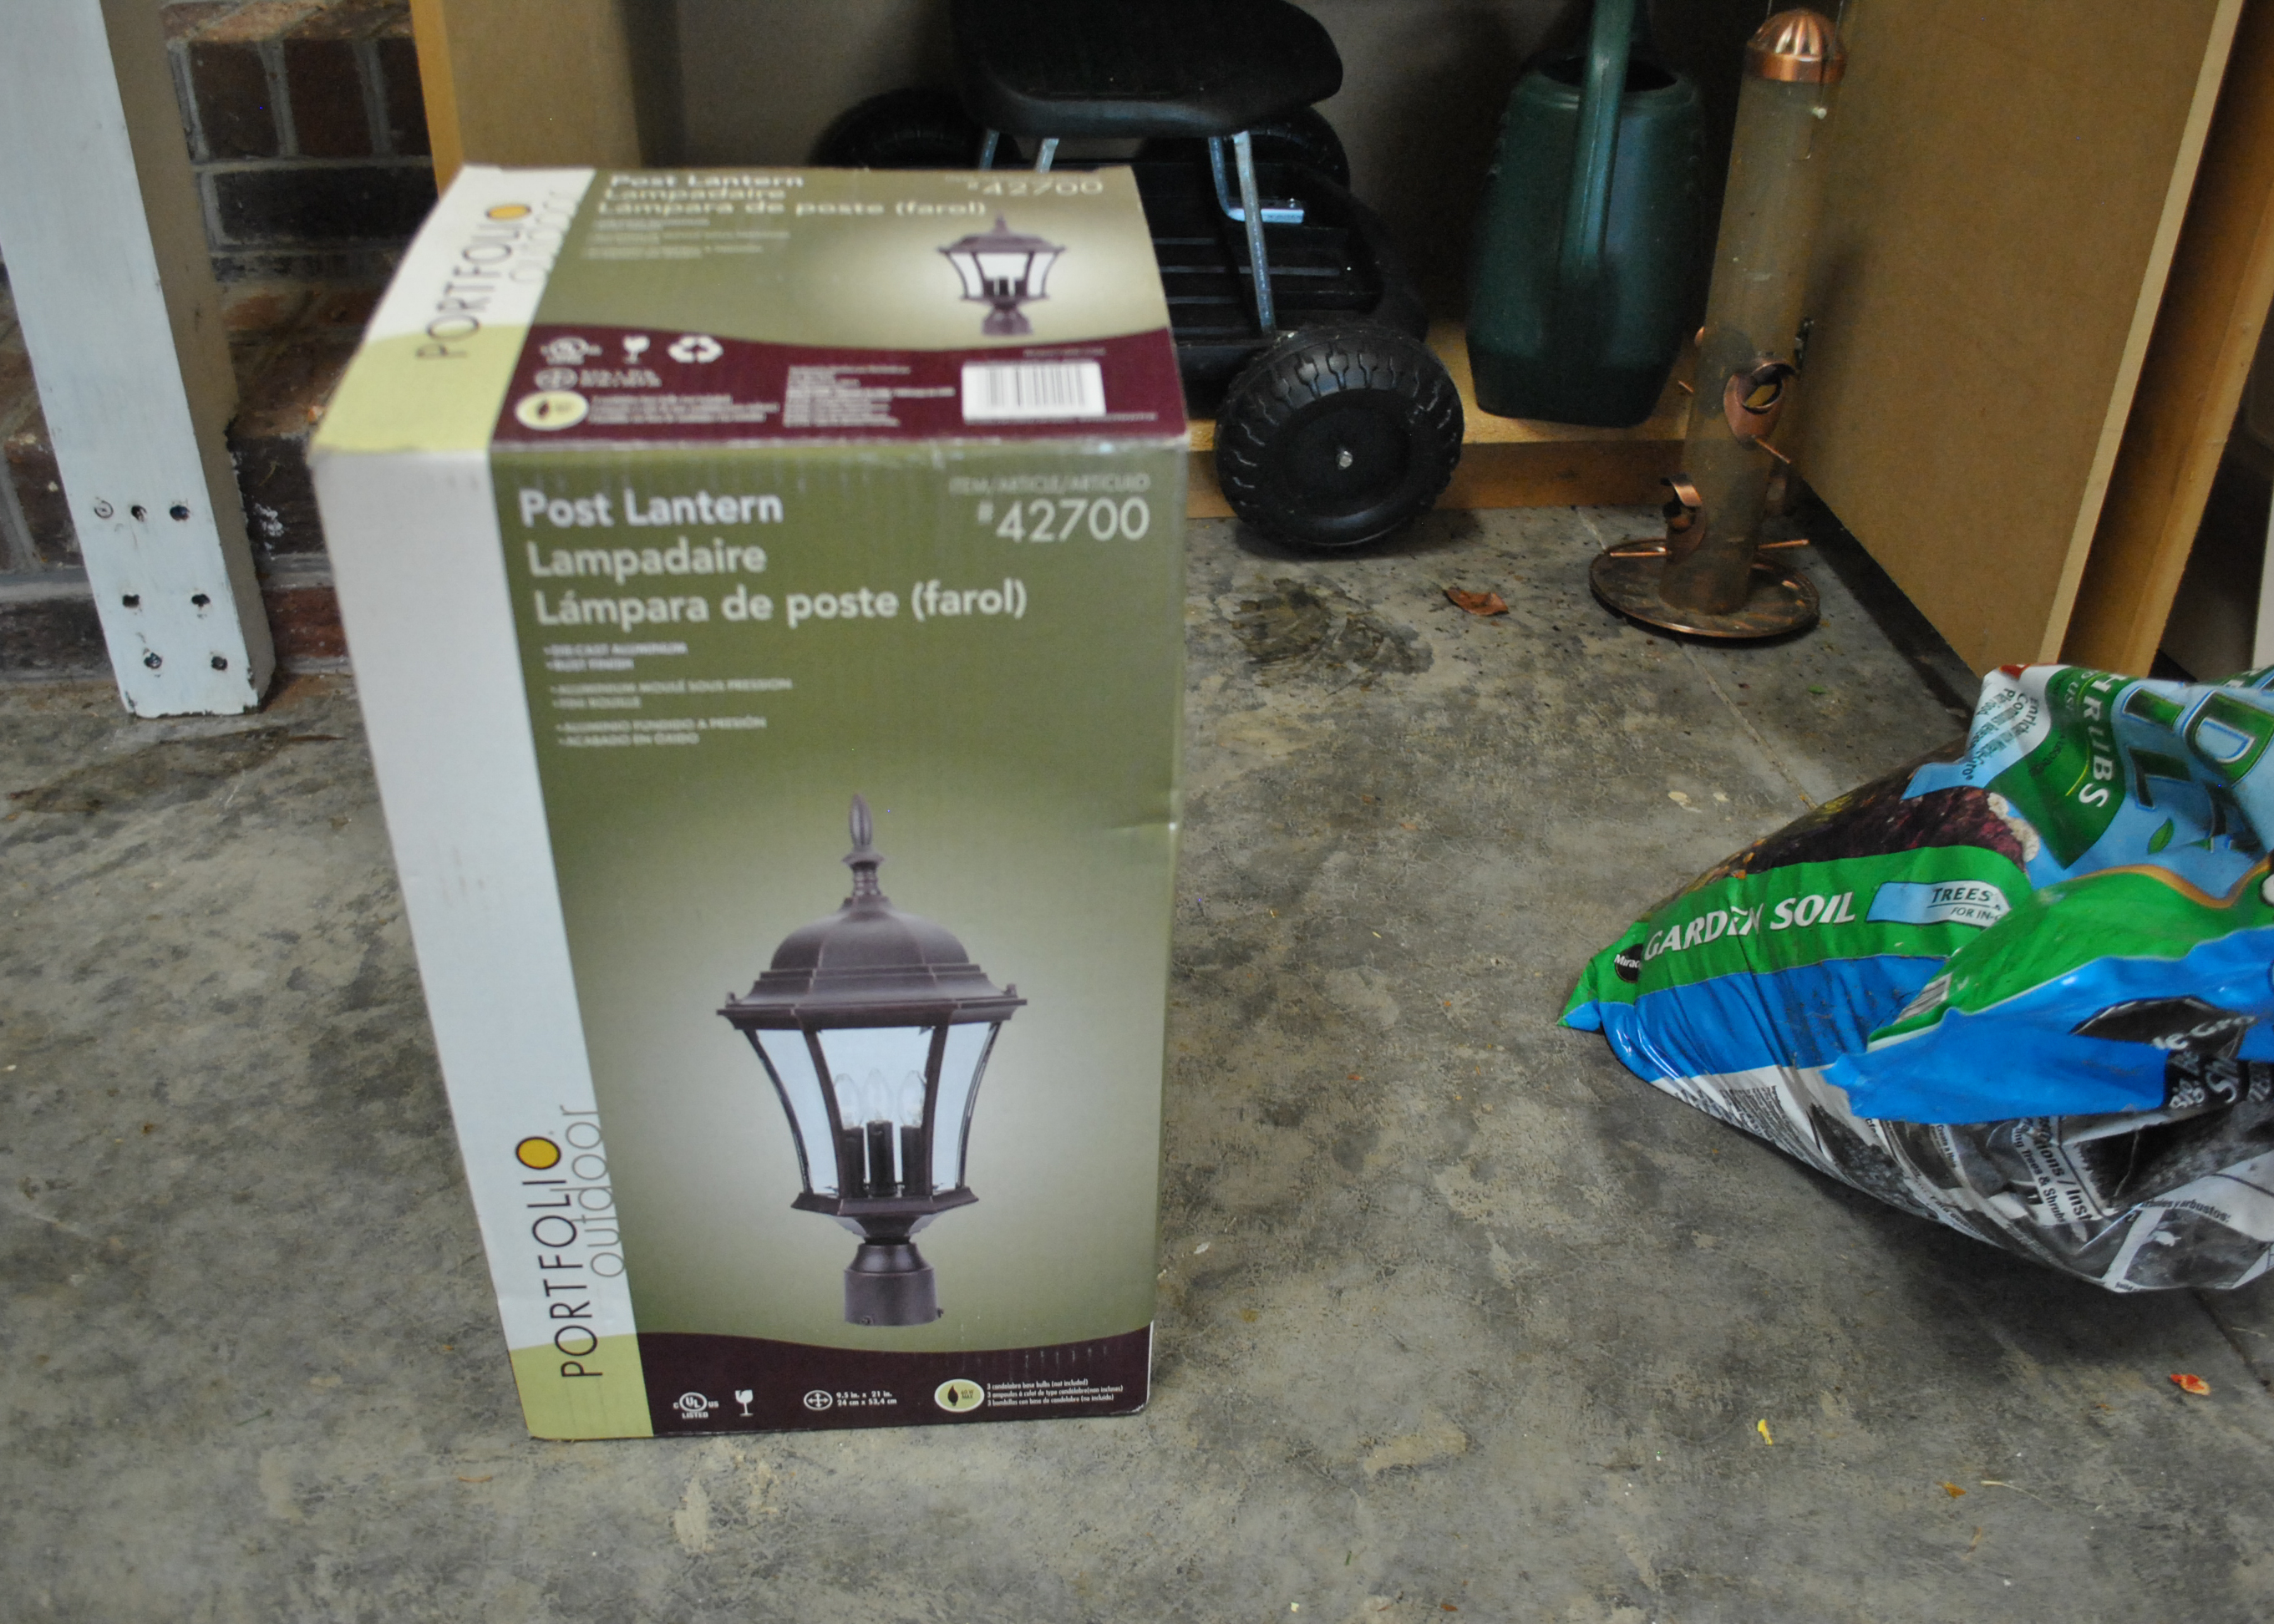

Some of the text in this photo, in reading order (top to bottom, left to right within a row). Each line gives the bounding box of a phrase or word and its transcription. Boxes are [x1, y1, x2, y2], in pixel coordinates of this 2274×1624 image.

[611, 175, 804, 189] Post Lantern
[745, 200, 785, 214] de
[795, 201, 885, 217] poste
[896, 200, 987, 217] (farol)
[519, 488, 784, 528] Post Lantern
[526, 536, 768, 586] Lampadaire
[534, 577, 1028, 632] Lámpara de poste (farol)
[1769, 892, 1856, 931] SOIL
[1931, 887, 1993, 904] TREES
[1951, 907, 1974, 917] FOR
[551, 1104, 626, 1278] outdoor
[515, 1135, 603, 1378] PORTFOLIO
